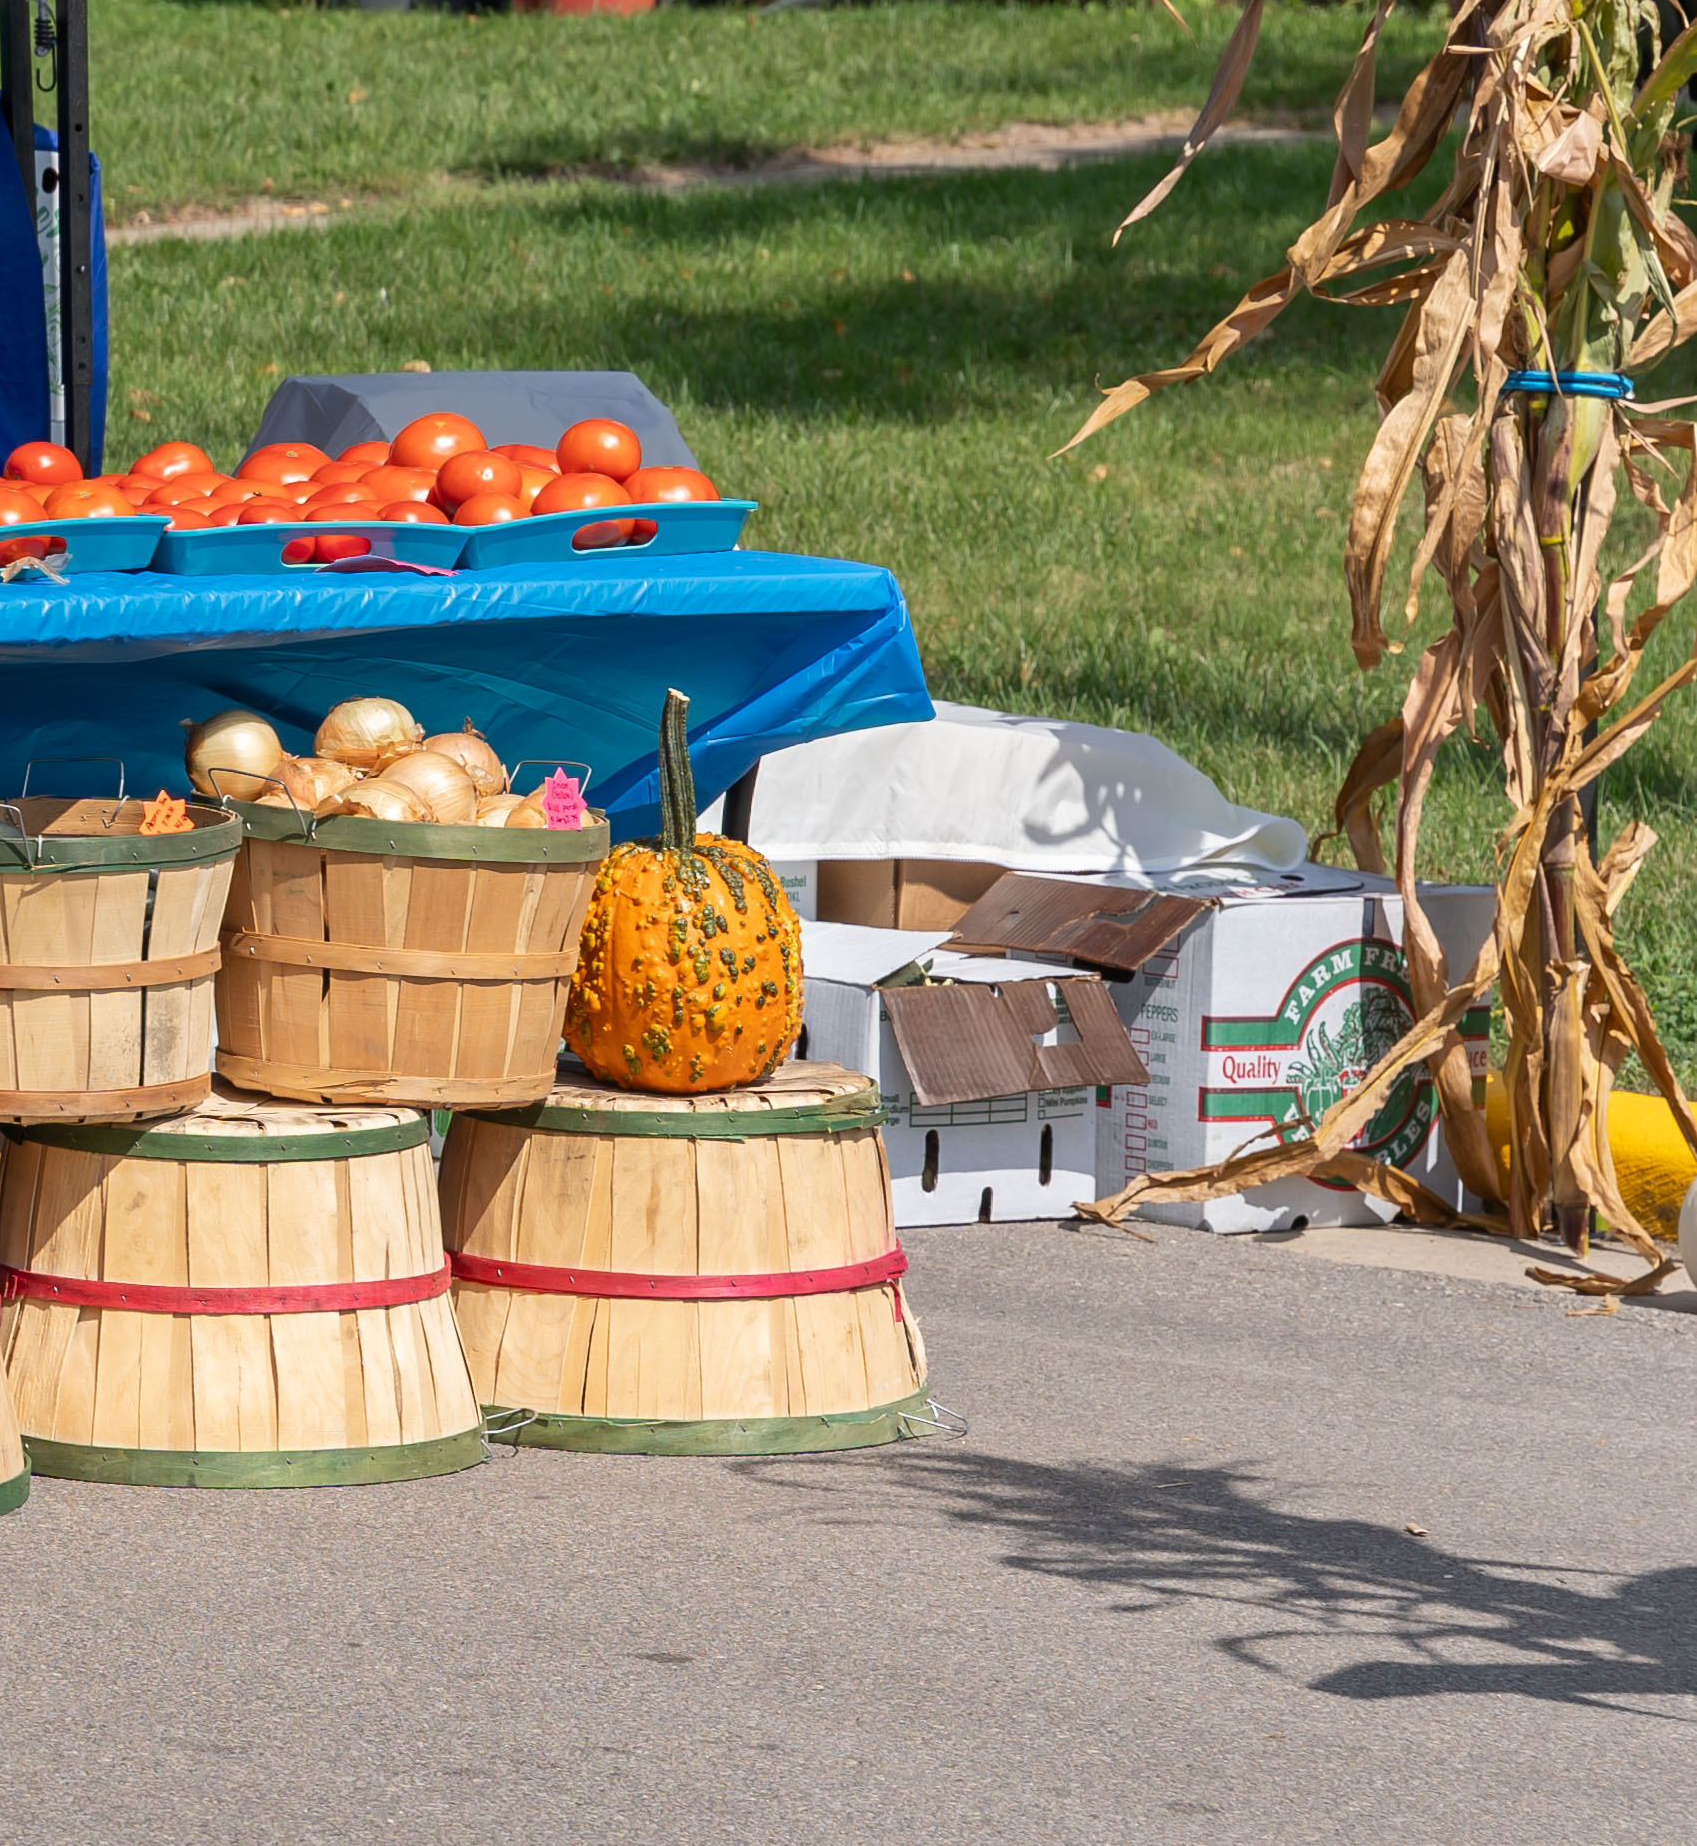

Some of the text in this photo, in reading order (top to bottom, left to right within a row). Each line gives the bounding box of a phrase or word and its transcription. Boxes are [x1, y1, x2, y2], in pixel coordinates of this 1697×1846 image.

[1284, 949, 1354, 1025] FARM
[1141, 1004, 1179, 1023] PEPPERS
[1222, 1055, 1280, 1084] Quality
[1149, 1096, 1167, 1107] SELECT
